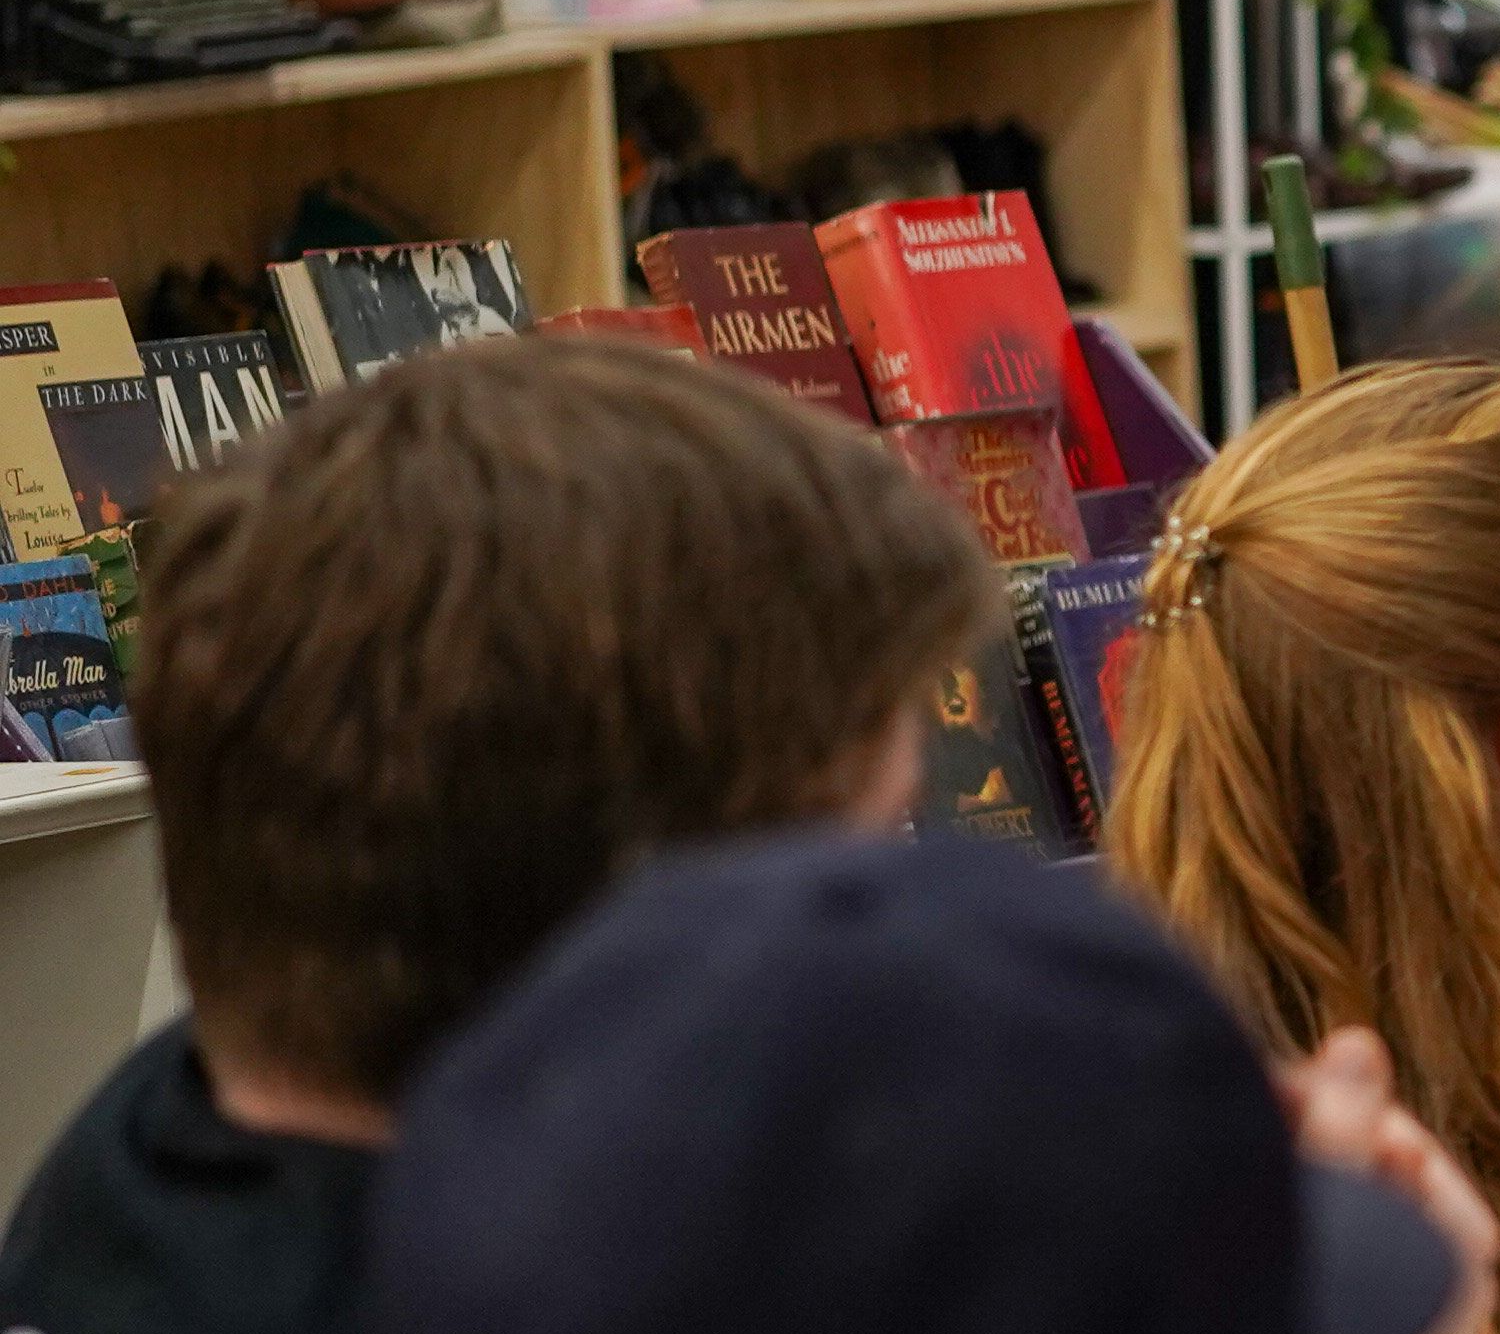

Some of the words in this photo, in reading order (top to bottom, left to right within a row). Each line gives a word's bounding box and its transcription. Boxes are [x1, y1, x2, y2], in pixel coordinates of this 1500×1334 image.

[714, 253, 789, 298] THE
[0, 324, 54, 350] SPER
[711, 304, 837, 355] AIRMEN
[42, 385, 85, 408] THE
[92, 380, 149, 405] DARK
[156, 364, 284, 471] MAN
[5, 505, 38, 524] hrilling
[37, 505, 60, 519] Tales
[60, 504, 71, 520] by
[22, 578, 83, 599] DAHL
[63, 655, 106, 686] Man
[60, 689, 107, 706] STORIES
